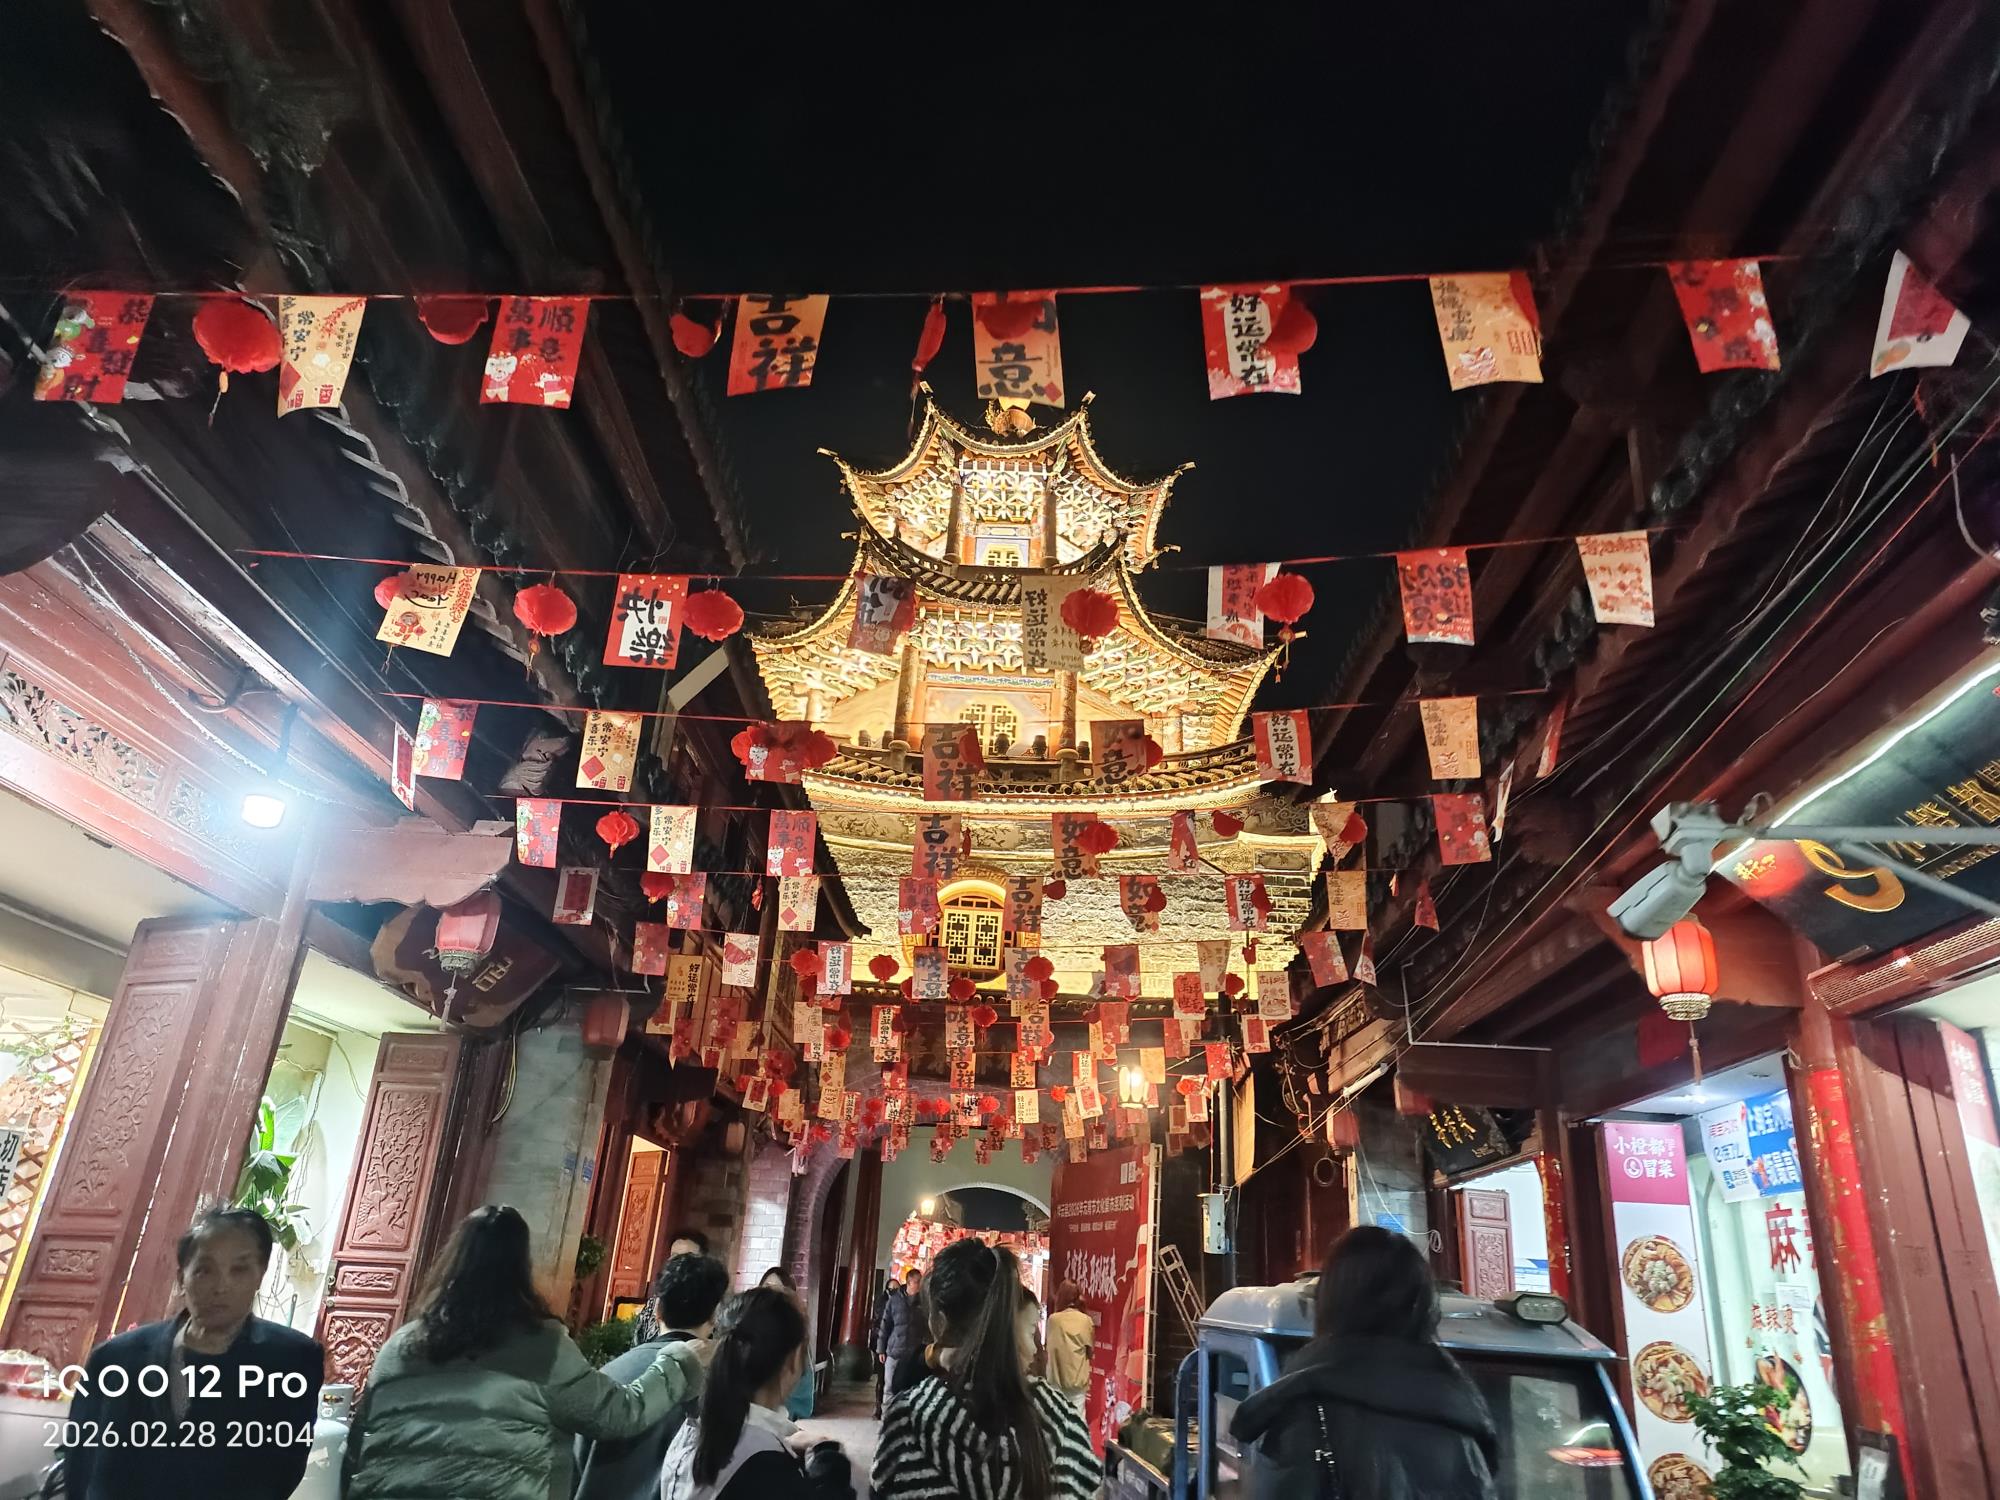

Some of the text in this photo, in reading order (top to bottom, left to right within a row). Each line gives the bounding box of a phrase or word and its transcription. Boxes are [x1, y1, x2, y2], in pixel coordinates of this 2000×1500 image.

[747, 294, 817, 392] 吉祥
[1230, 294, 1270, 387] 好运常在
[928, 727, 977, 800] 吉祥
[1271, 713, 1297, 776] 好运常在
[920, 814, 959, 879] 吉祥
[1009, 876, 1041, 932] 吉祥
[1643, 1158, 1676, 1179] 冒菜
